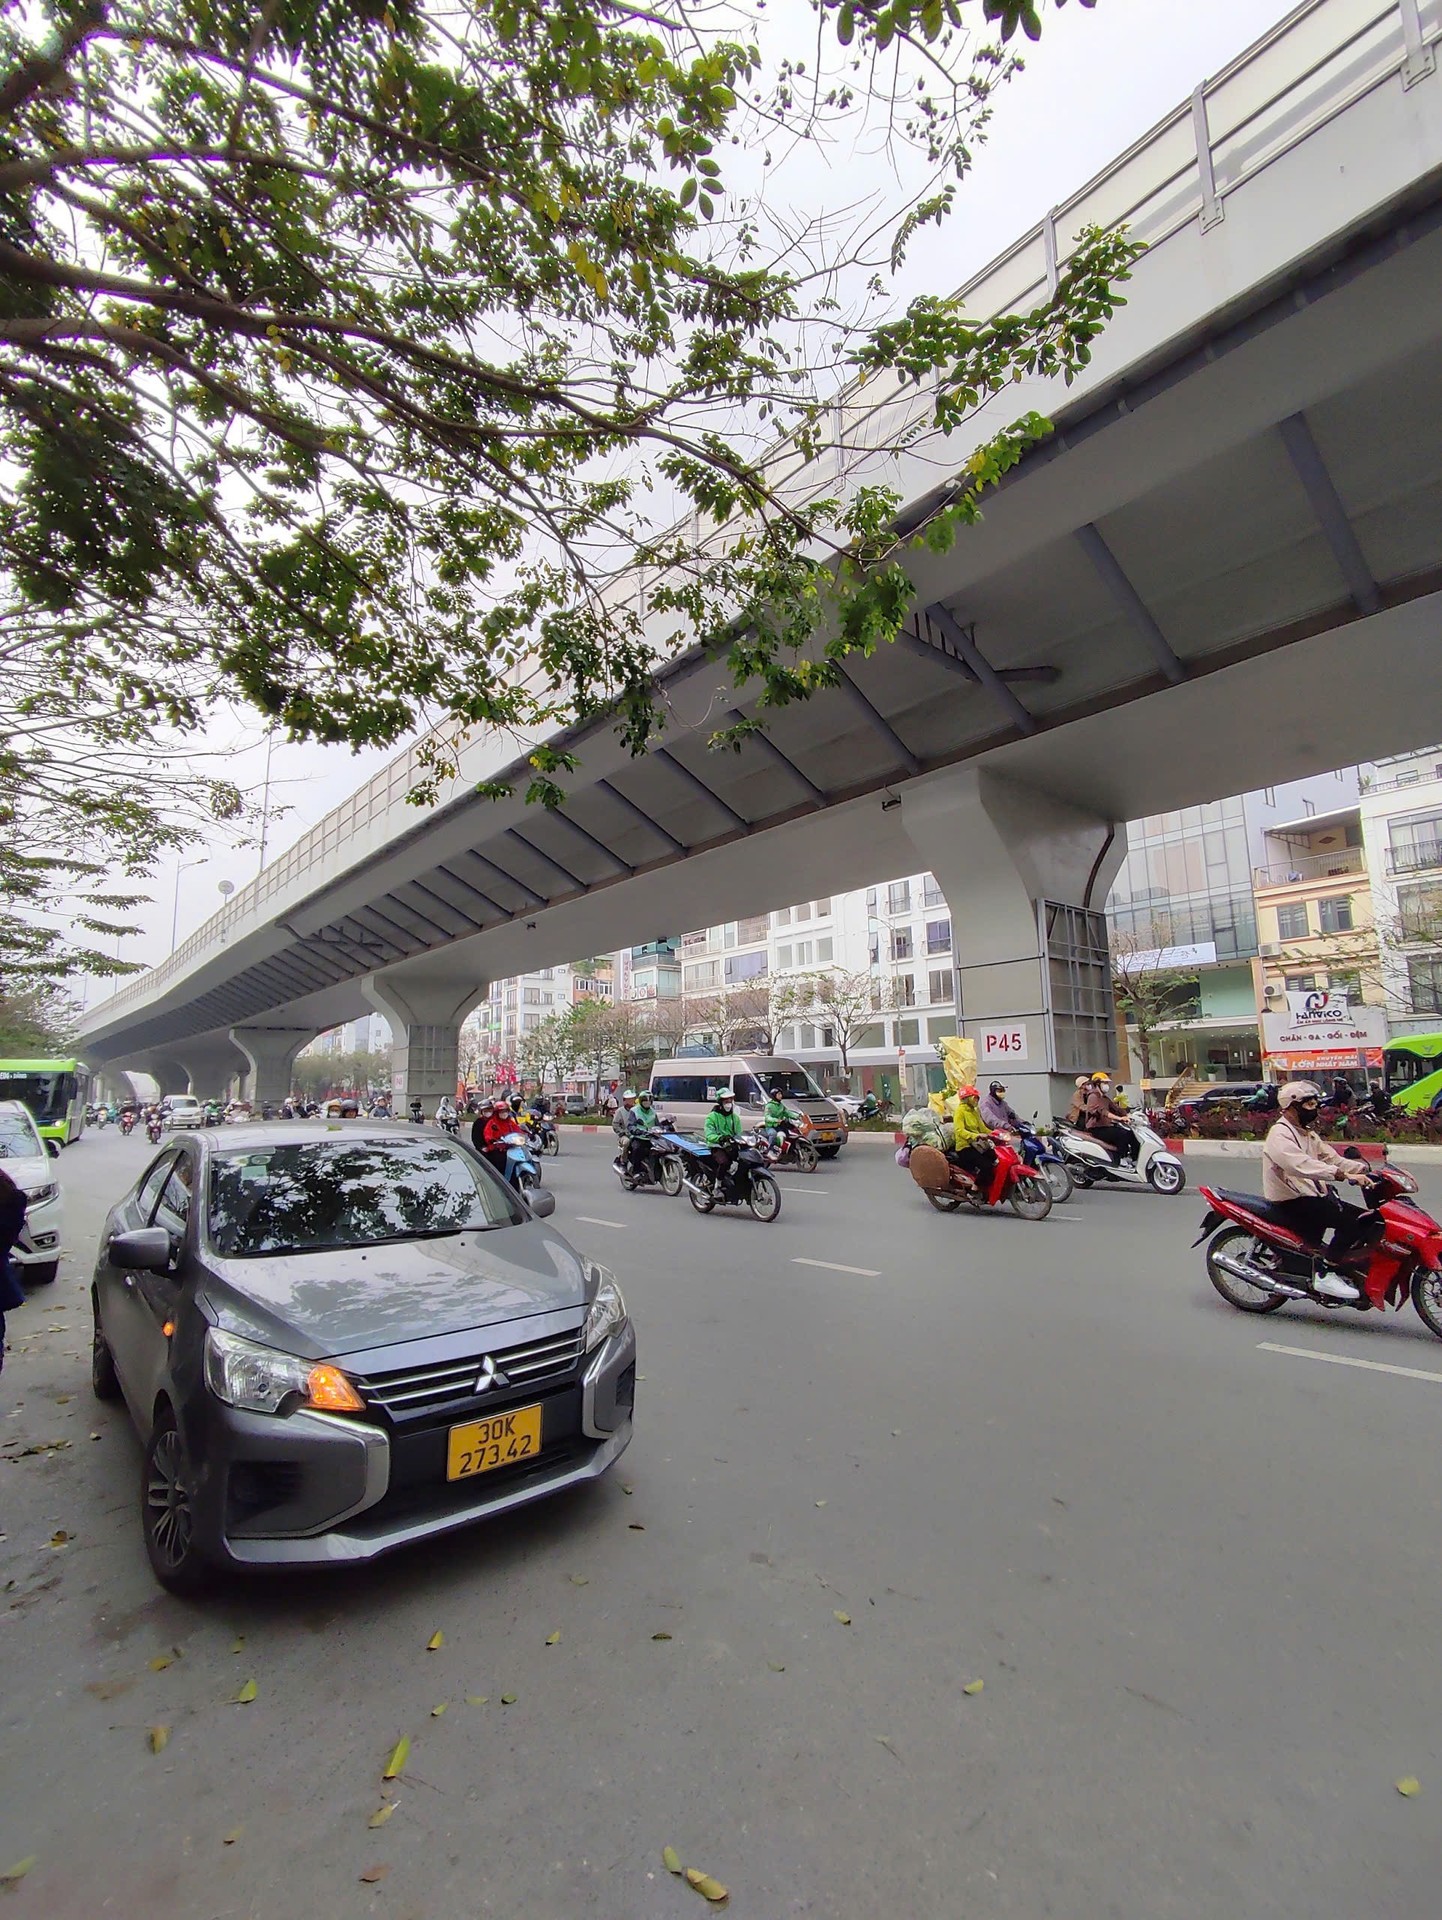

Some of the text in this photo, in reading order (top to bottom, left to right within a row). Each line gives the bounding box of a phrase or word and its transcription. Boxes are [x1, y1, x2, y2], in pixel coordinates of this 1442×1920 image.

[986, 1033, 1022, 1053] P45
[478, 1415, 516, 1444] 30K
[459, 1434, 531, 1474] 273.42
